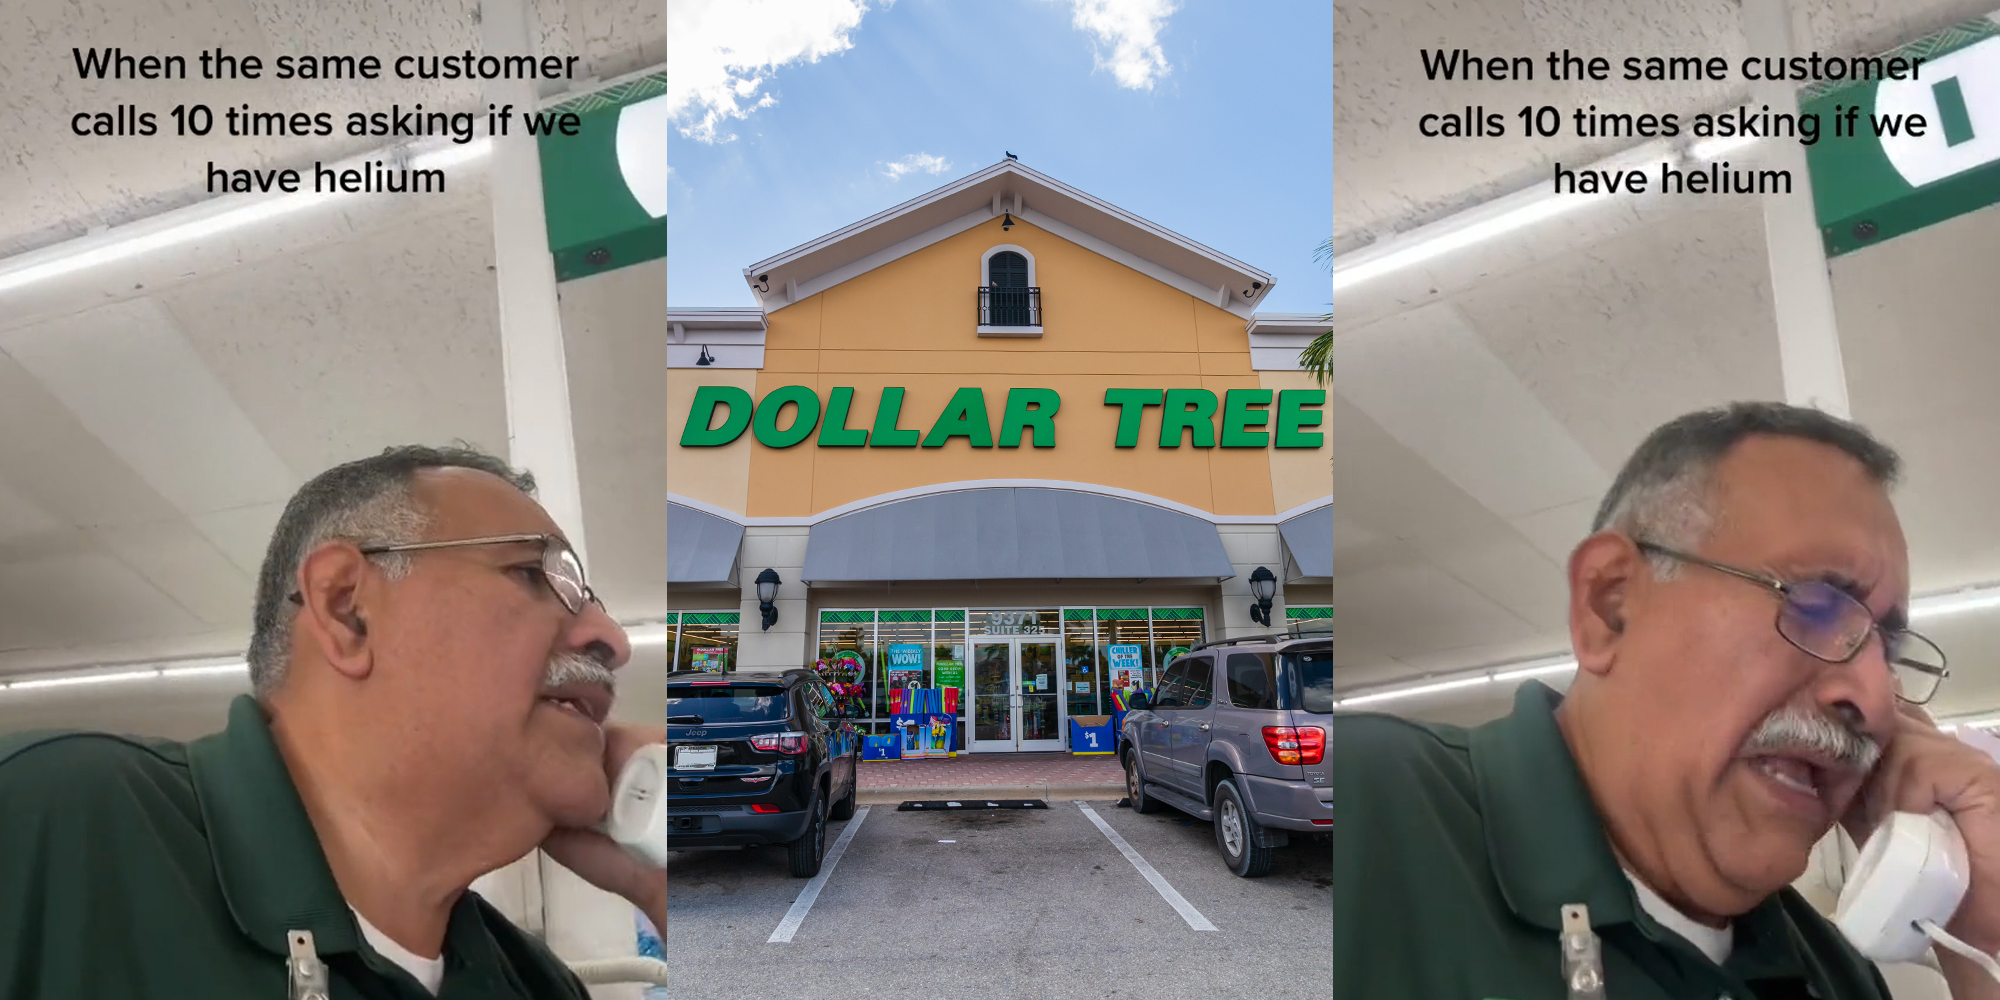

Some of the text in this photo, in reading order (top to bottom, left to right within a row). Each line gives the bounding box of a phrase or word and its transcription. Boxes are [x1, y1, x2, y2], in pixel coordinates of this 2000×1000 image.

[679, 385, 1326, 449] DOLLAR TREE
[991, 610, 1037, 625] 9371
[984, 625, 1046, 635] SUITE 325
[1111, 646, 1138, 655] CHILLER
[891, 653, 922, 665] WOW!
[1112, 659, 1139, 668] WEEK!
[685, 729, 708, 737] Jeep
[1084, 730, 1099, 748] $1
[878, 747, 886, 757] $1
